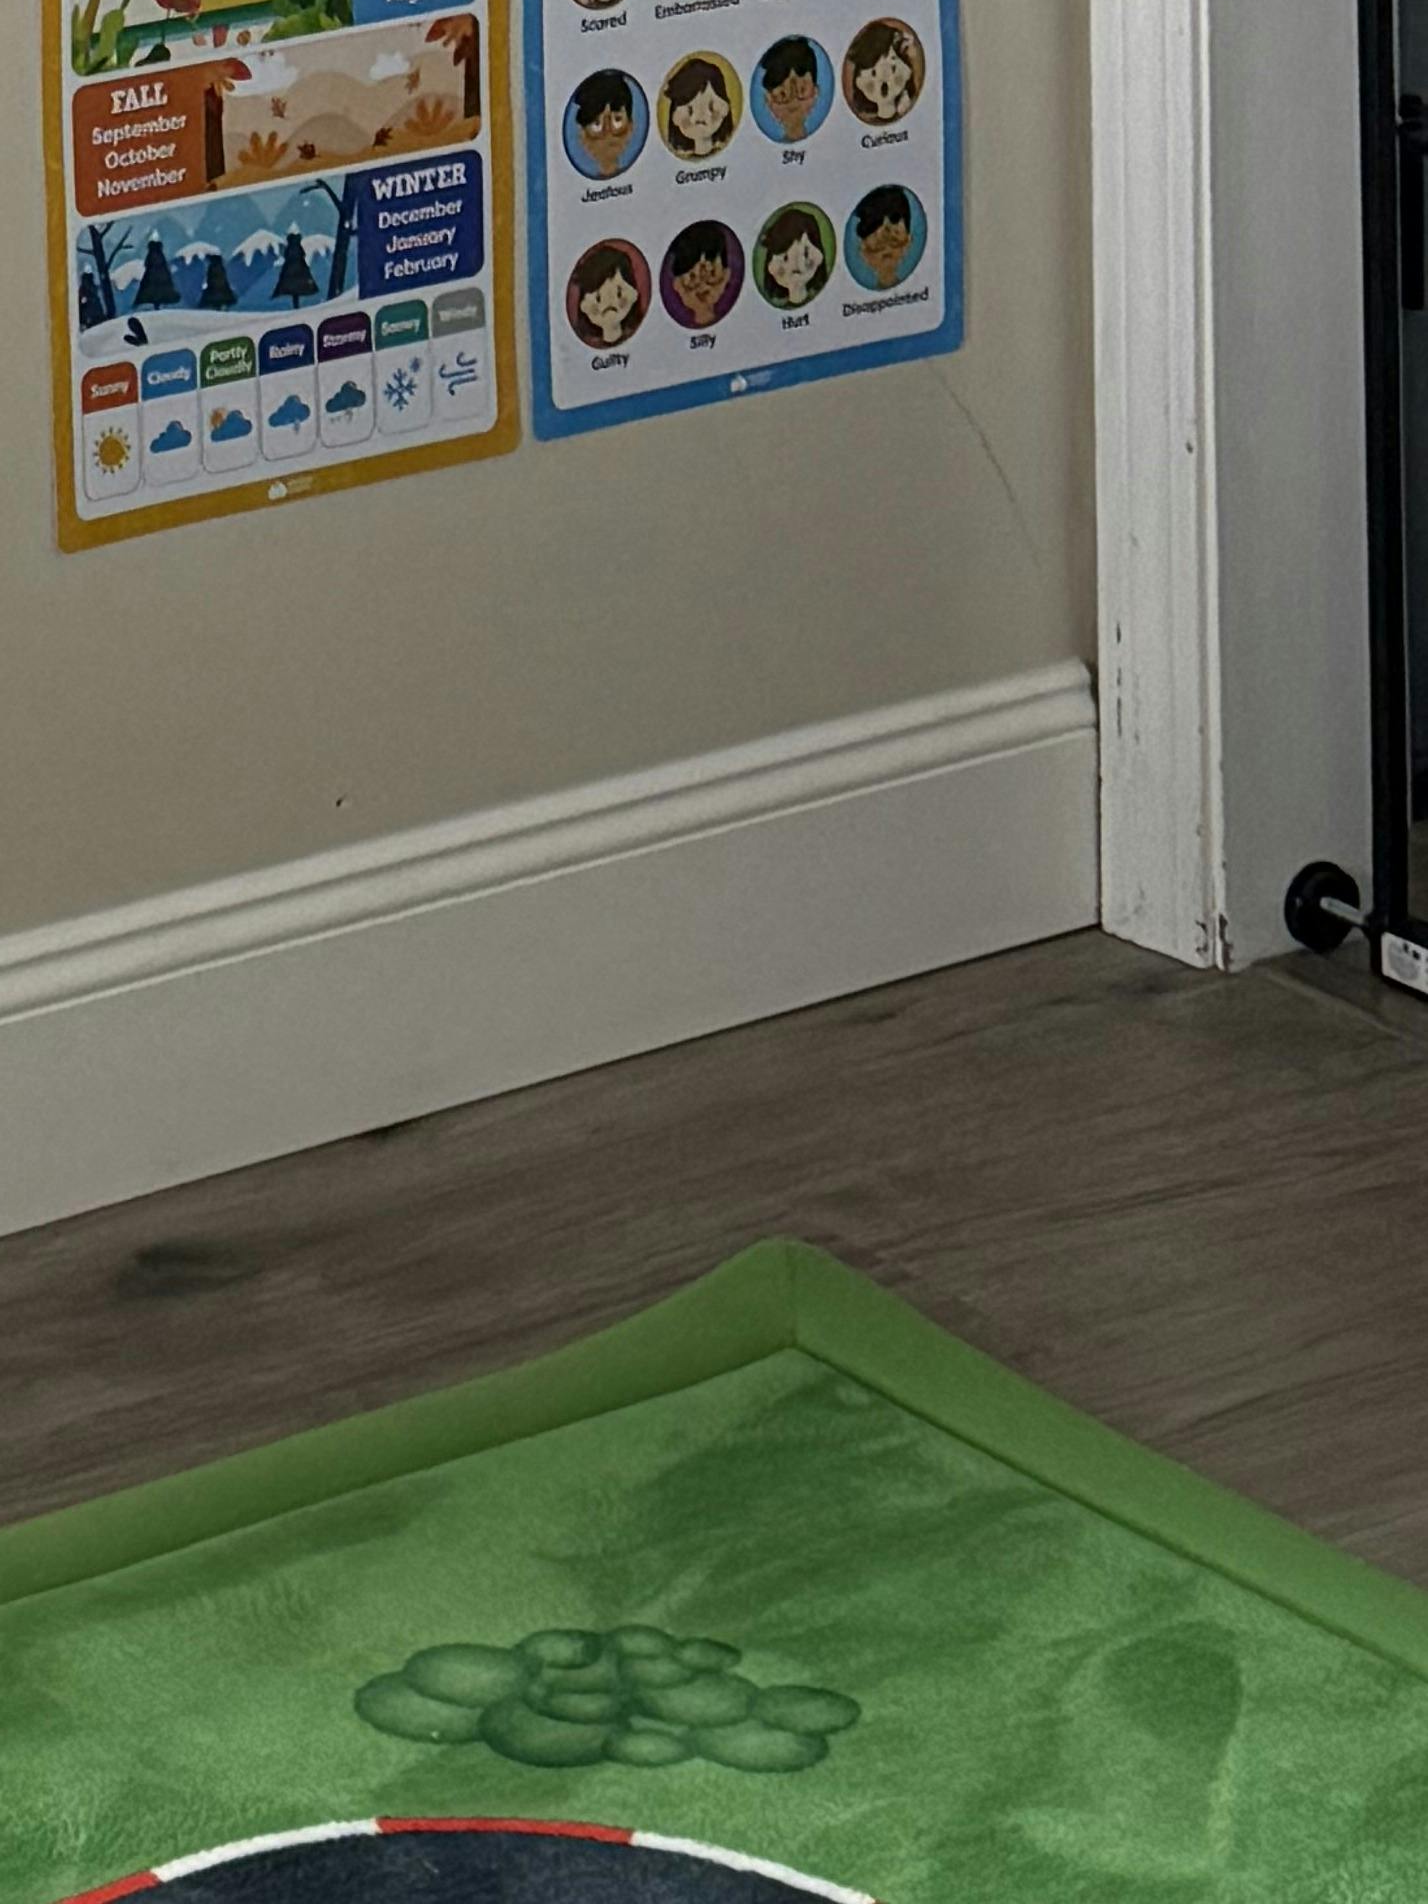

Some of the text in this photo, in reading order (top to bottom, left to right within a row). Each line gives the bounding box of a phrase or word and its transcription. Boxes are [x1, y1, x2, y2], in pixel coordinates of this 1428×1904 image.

[581, 12, 627, 32] Scared
[110, 82, 168, 115] FALL
[92, 114, 186, 147] September
[861, 130, 908, 148] Curious
[104, 144, 176, 169] October
[782, 150, 805, 165] Shy
[97, 166, 186, 198] November
[372, 162, 467, 200] WINTER
[675, 166, 727, 184] Grumpy
[581, 184, 633, 202] Jealous
[378, 198, 463, 229] December
[386, 225, 456, 254] January
[384, 251, 459, 280] February
[843, 286, 928, 317] Disappointed
[782, 314, 809, 329] Hurt
[210, 346, 248, 363] Partly
[591, 354, 629, 370] Guilty
